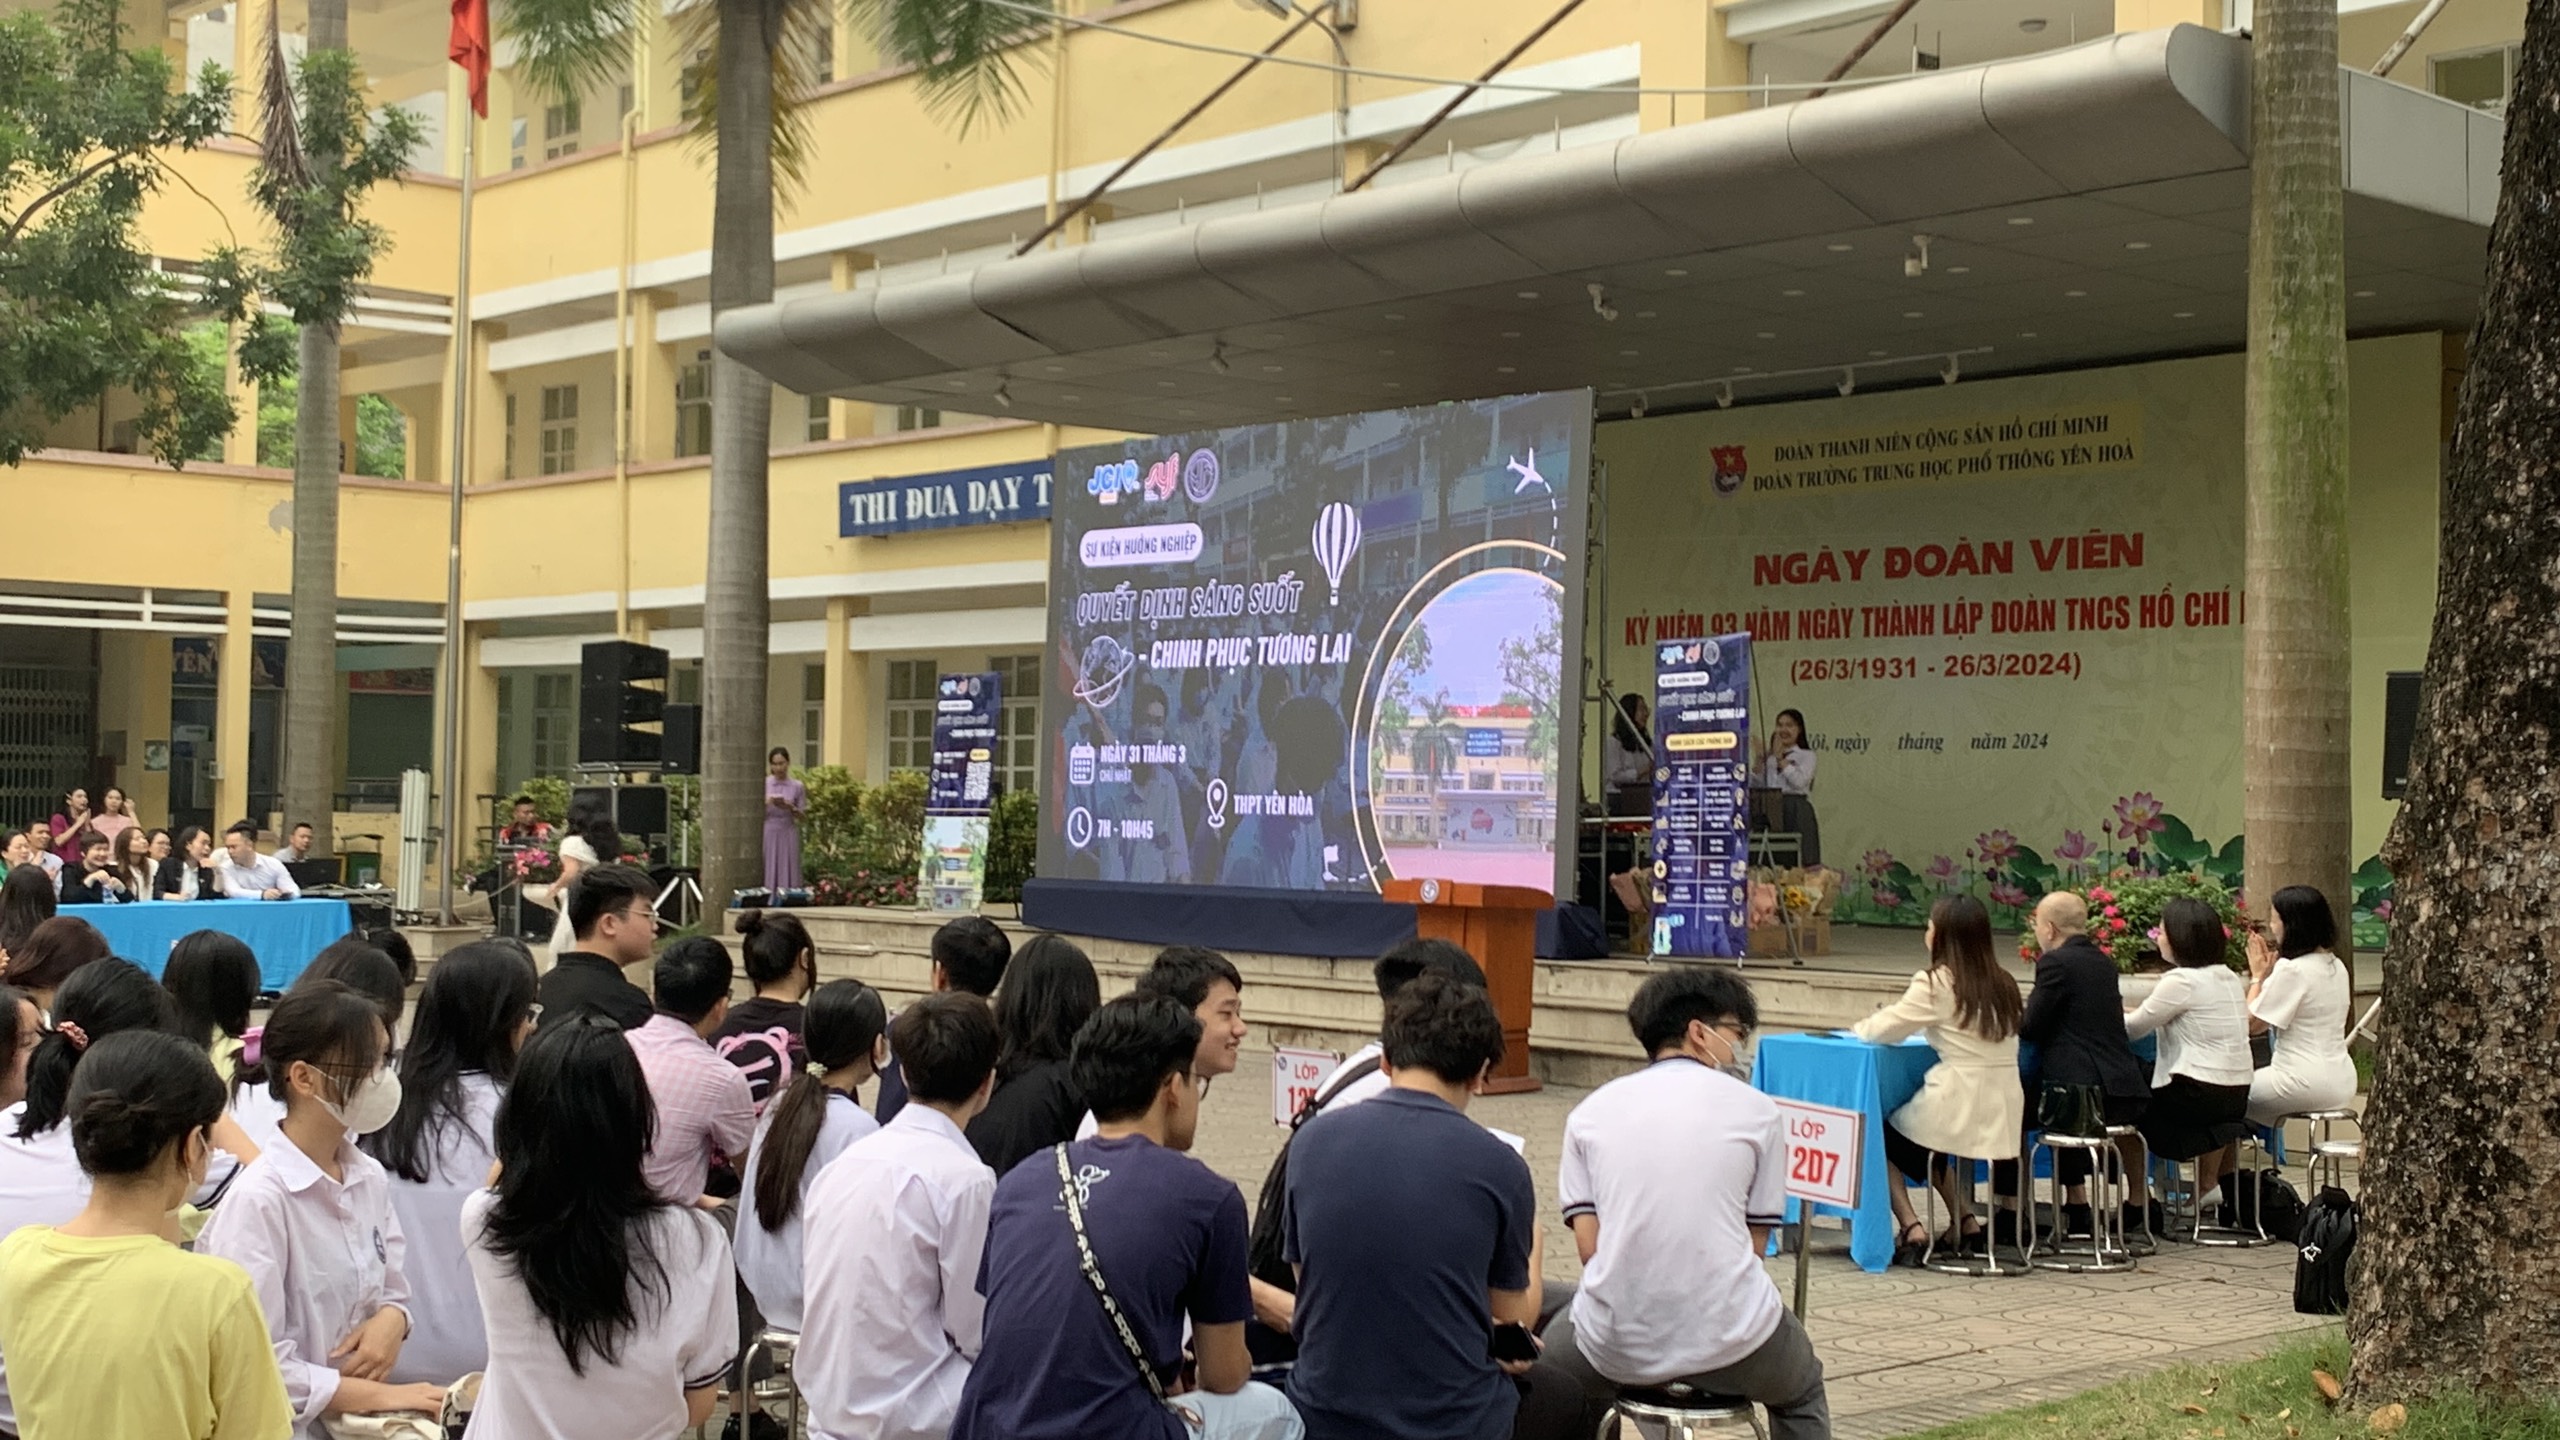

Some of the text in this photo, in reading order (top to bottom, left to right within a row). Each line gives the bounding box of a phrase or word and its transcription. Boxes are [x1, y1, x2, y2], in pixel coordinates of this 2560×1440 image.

[1819, 438, 1870, 459] THANH
[1875, 431, 1912, 451] NIÊN
[1915, 427, 1958, 452] CỘNG
[1999, 415, 2023, 442] HỒ
[2028, 413, 2058, 439] CHÍ
[2062, 415, 2109, 436] MINH
[1797, 463, 1857, 488] TRƯỜNG
[1863, 463, 1914, 483] TRUNG
[1920, 459, 1953, 481] HỌC
[1997, 449, 2054, 471] THÔNG
[2060, 443, 2093, 466] YÊN
[850, 490, 899, 525] THI
[906, 484, 959, 520] ĐUA
[967, 476, 1024, 521] DẠY
[1085, 540, 1098, 561] SỰ
[1101, 536, 1121, 560] KIỆN
[1161, 531, 1197, 555] NGHIỆP
[1753, 528, 2144, 586] NGÀY ĐOÀN VIÊN
[1076, 580, 1137, 626] QUYẾT
[1190, 578, 1246, 619] SÁNG
[1248, 570, 1304, 614] SUỐT
[1625, 608, 1650, 646] KỶ
[1711, 612, 1738, 636] 93
[1745, 605, 1790, 642] NĂM
[1798, 602, 1854, 641] NGÀY
[1862, 599, 1935, 638] THÀNH
[1942, 596, 1983, 640] LẬP
[1991, 594, 2056, 633] ĐOÀN
[2065, 595, 2130, 632] TNCS
[2140, 582, 2175, 628] HỒ
[2184, 584, 2230, 627] CHÍ
[1151, 638, 1202, 668] CHINH
[1205, 636, 1252, 675] PHỤC
[1257, 633, 1316, 667] TƯƠNG
[1320, 632, 1352, 664] LAI
[1791, 656, 1917, 686] (26/3/1931
[1944, 652, 2082, 681] 26/3/2024)
[1100, 740, 1186, 763] NGÀY 31 THÁNG 3
[1834, 732, 1872, 755] ngày
[1898, 731, 1944, 754] tháng
[1970, 732, 2007, 750] năm
[2012, 732, 2049, 750] 2024
[1233, 789, 1313, 816] THPT YÊN HÒA
[1097, 819, 1111, 838] 7H
[1121, 820, 1154, 839] 10H45
[1294, 1060, 1320, 1081] LỚP
[1288, 1085, 1317, 1114] 12
[1791, 1115, 1826, 1142] LỚP
